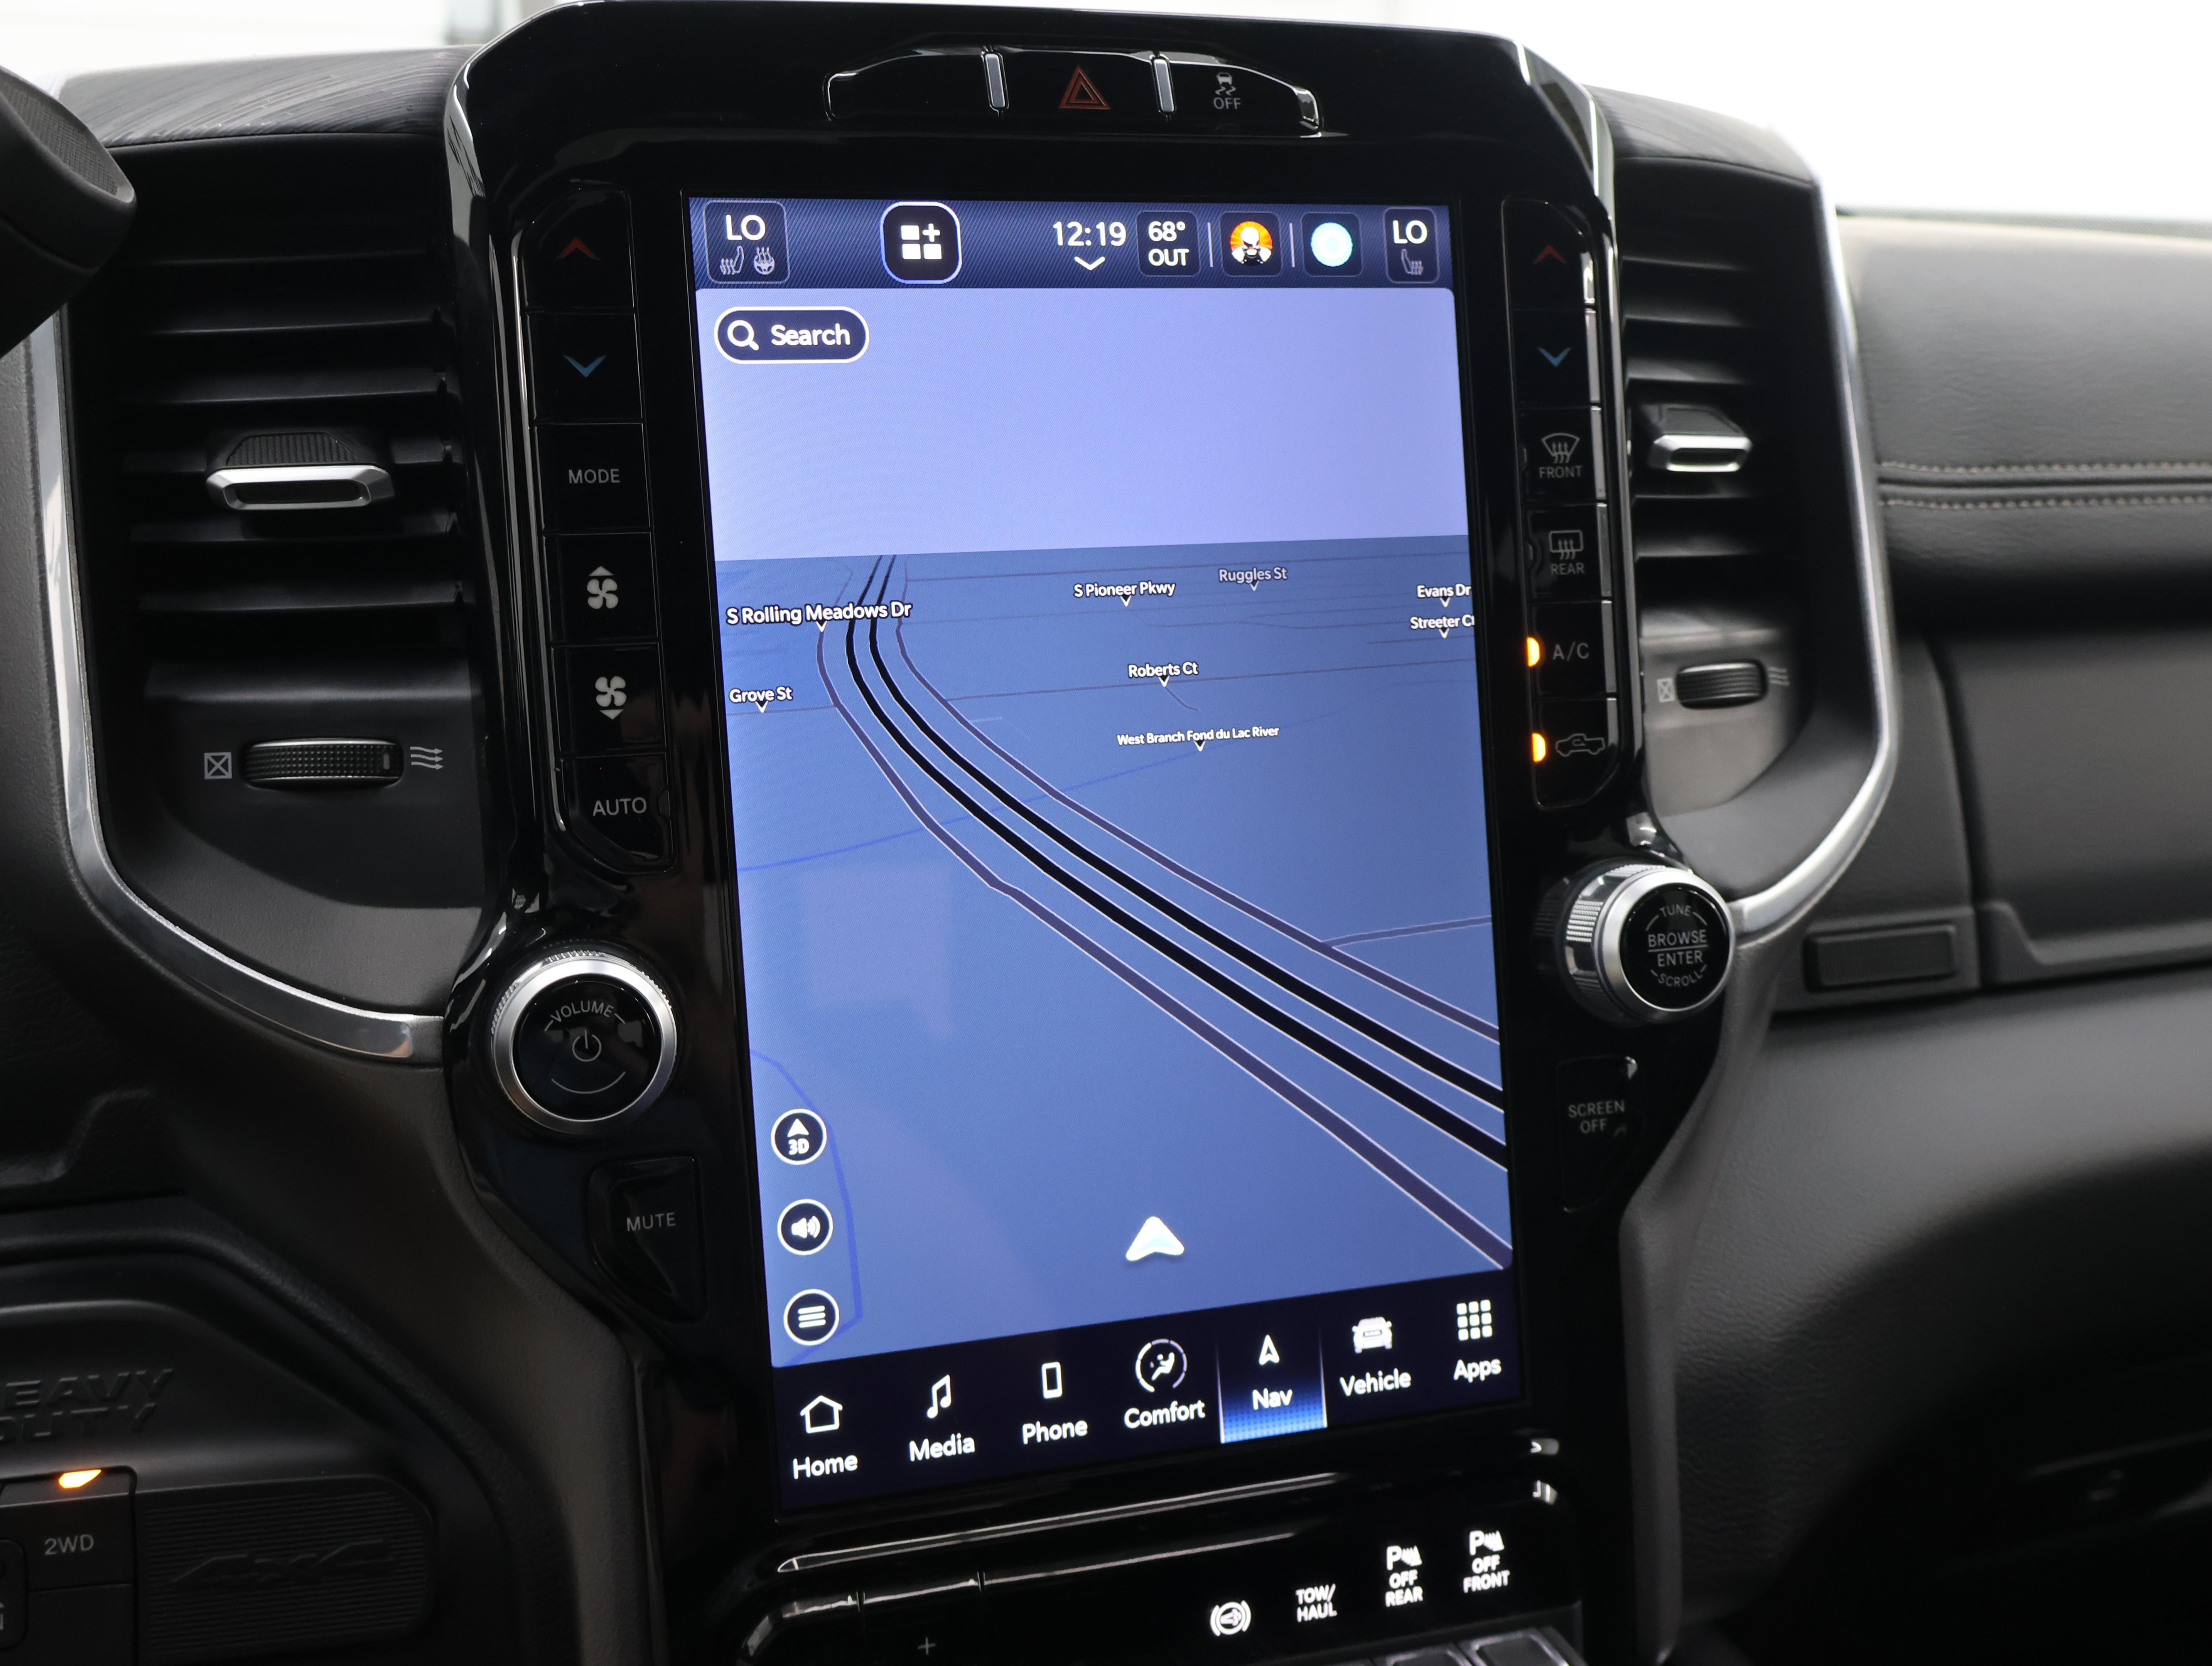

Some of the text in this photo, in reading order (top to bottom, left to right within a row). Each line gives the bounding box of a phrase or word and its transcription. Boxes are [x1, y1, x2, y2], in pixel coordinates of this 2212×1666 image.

[1213, 97, 1242, 110] OFF
[725, 214, 766, 241] LO
[1053, 221, 1127, 247] 12:19
[1148, 221, 1186, 242] 68°
[1392, 219, 1428, 245] LO
[1148, 248, 1190, 266] OUT
[771, 322, 851, 346] Search
[568, 468, 621, 484] MODE
[1539, 465, 1582, 479] FRONT
[1219, 567, 1287, 583] Ruggles St
[1549, 562, 1585, 575] REAR
[1074, 582, 1176, 597] S Pioneer Pkwy
[1417, 583, 1472, 597] Evans Dr
[726, 602, 912, 624] S Rolling Meadows Dr
[1410, 616, 1460, 629] Streeter
[1552, 642, 1589, 660] A/C
[1129, 662, 1198, 678] Roberts Ct
[729, 686, 793, 703] Grove St
[1117, 726, 1279, 745] West Branch Fond du Lac River
[592, 797, 647, 817] AUTO
[1659, 904, 1692, 917] TUNE
[1648, 929, 1708, 948] BROWSE
[1657, 949, 1703, 966] ENTER
[1658, 972, 1702, 987] SCROLL
[551, 1000, 614, 1024] VOLUME
[1568, 1100, 1625, 1118] SCREEN
[1579, 1118, 1608, 1135] OFF
[788, 1138, 810, 1155] 3D
[626, 1212, 676, 1232] MUTE
[1453, 1359, 1502, 1383] Apps
[1339, 1368, 1412, 1397] Vehicle
[1252, 1388, 1293, 1411] Nav
[1124, 1400, 1206, 1429] Comfort
[1022, 1420, 1088, 1445] Phone
[909, 1432, 975, 1462] Media
[793, 1454, 858, 1480] Home
[44, 1534, 94, 1556] 2WD
[1472, 1555, 1500, 1573] OFF
[1389, 1570, 1418, 1588] OFF
[1463, 1570, 1510, 1593] FRONT
[1295, 1583, 1336, 1605] TOW/
[1385, 1586, 1424, 1607] REAR
[1296, 1602, 1338, 1623] HAUL
